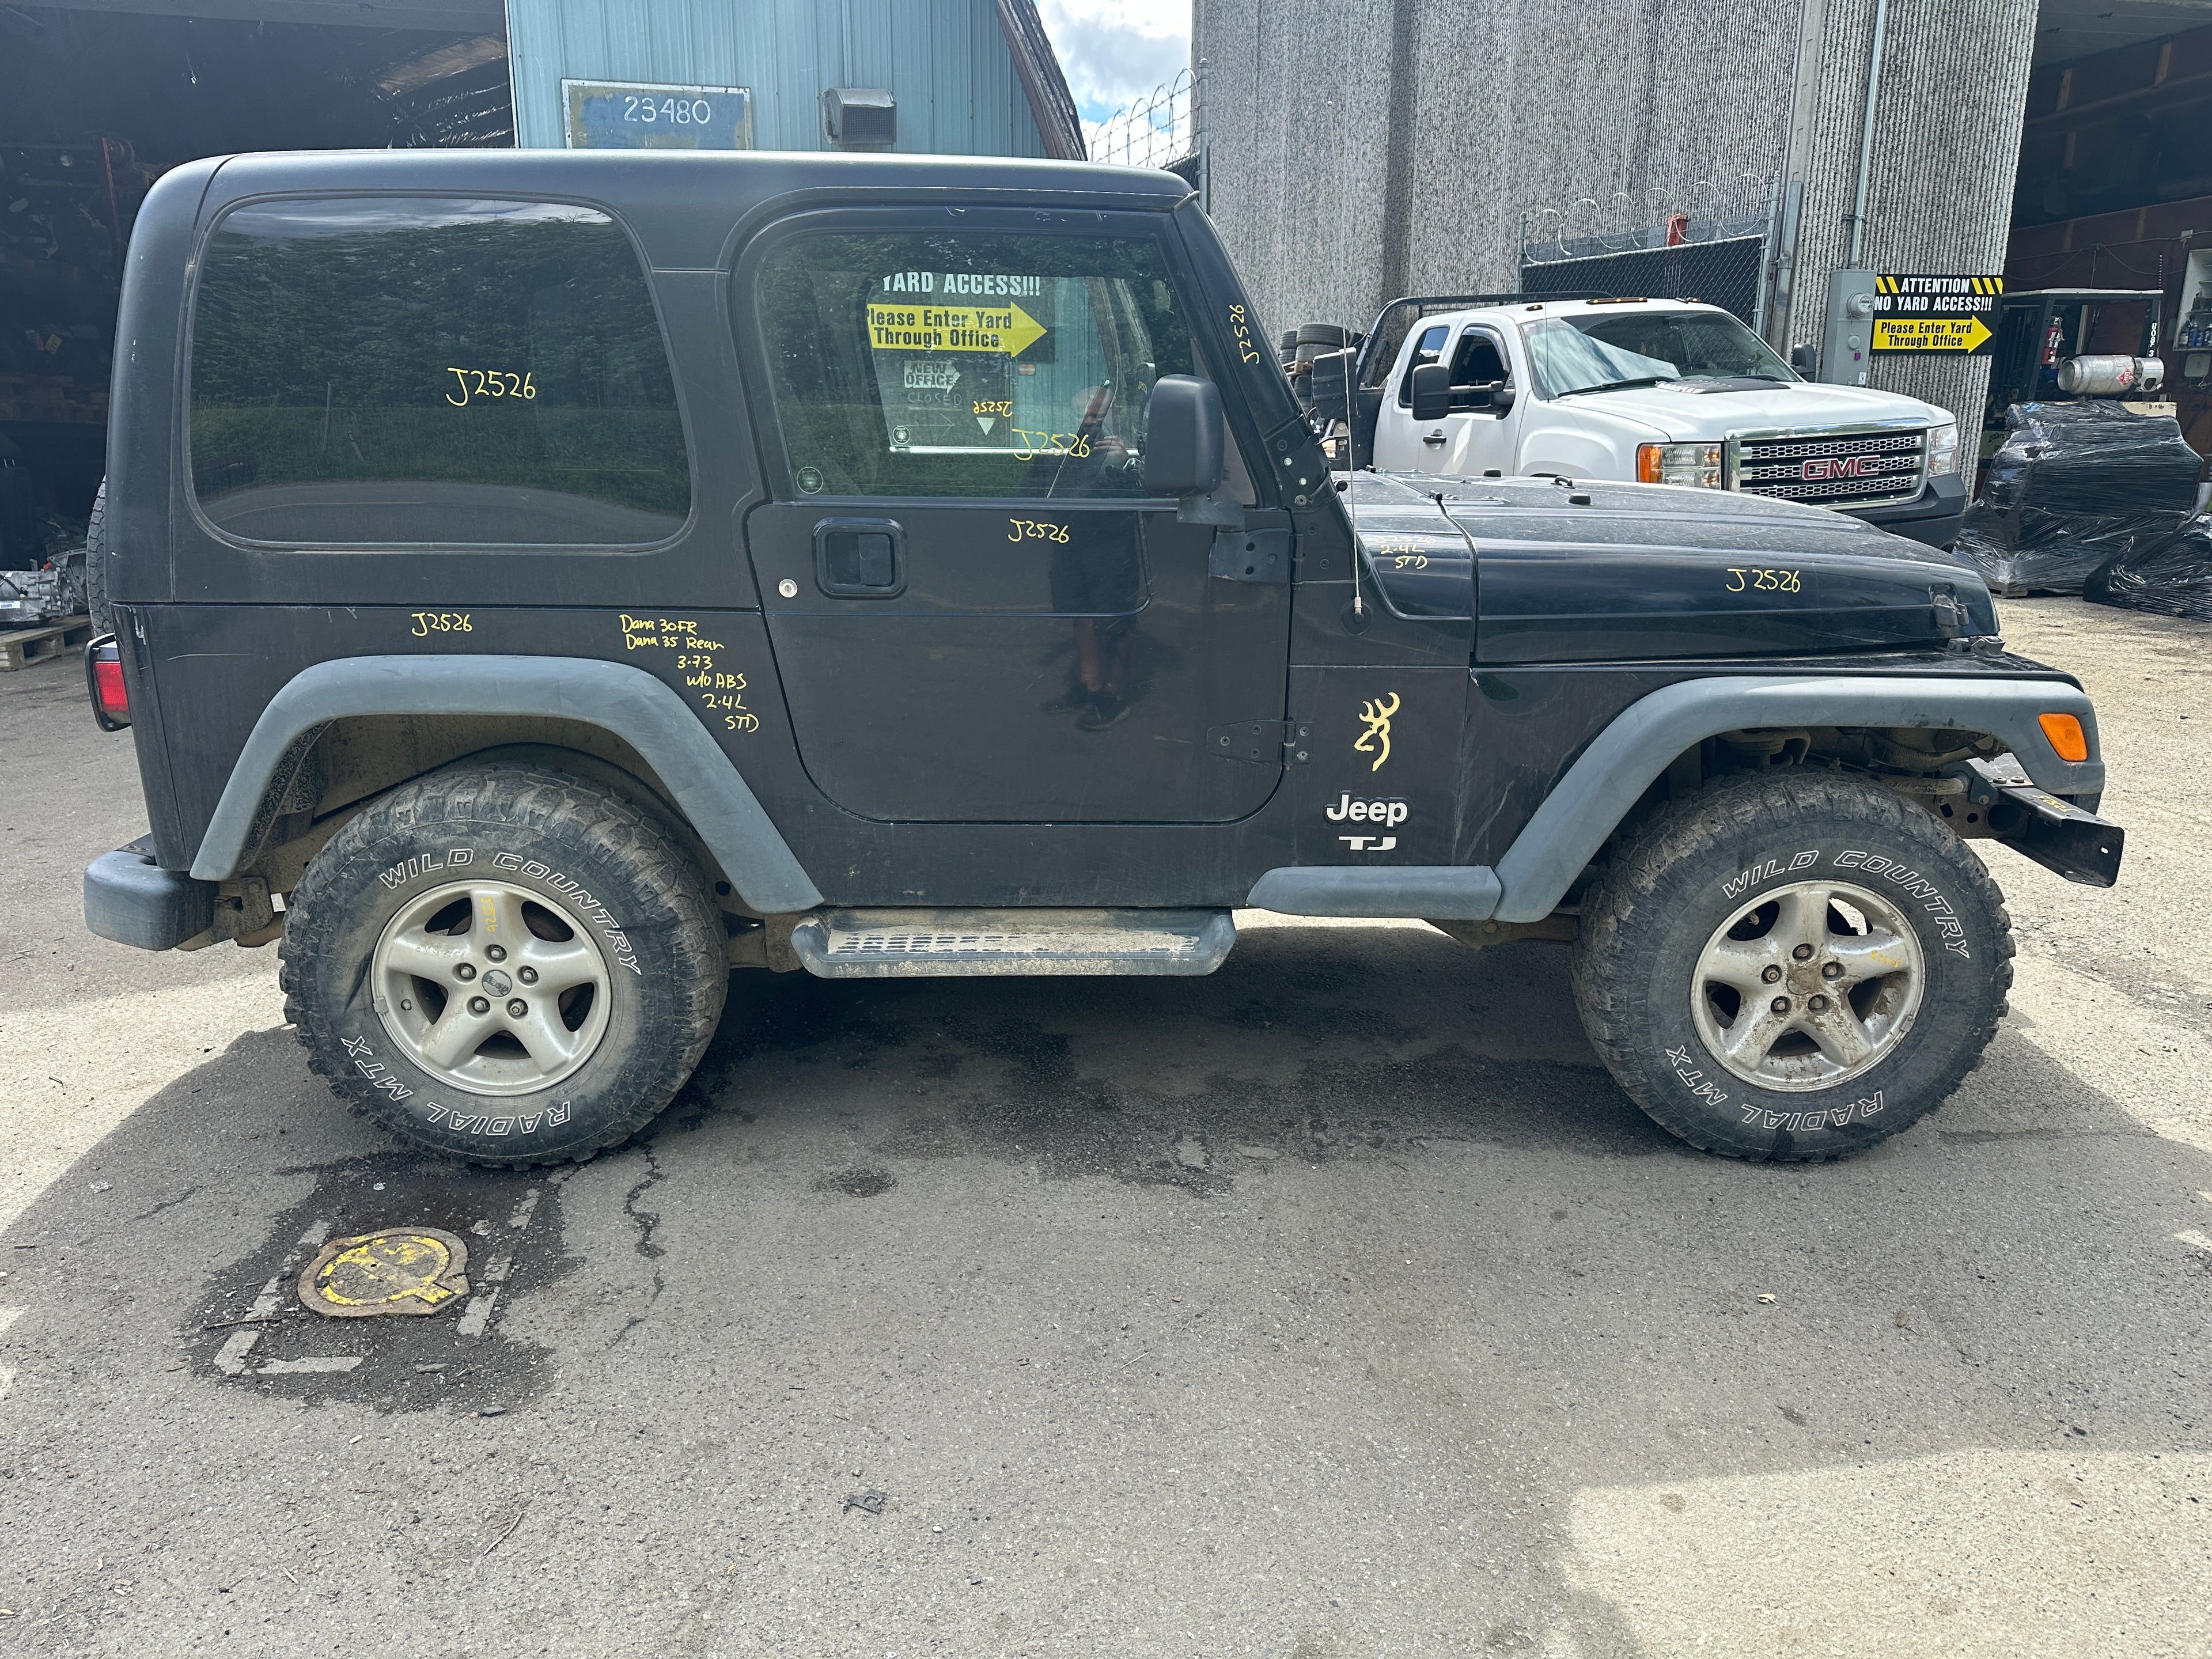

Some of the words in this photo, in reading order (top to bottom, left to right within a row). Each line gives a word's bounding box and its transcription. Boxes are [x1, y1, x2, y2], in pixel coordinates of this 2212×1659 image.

[623, 94, 712, 126] 23480
[943, 274, 1040, 296] ACCESS!!!
[1900, 278, 1970, 293] ATTENTION
[1874, 296, 1892, 311] NO
[1897, 296, 1929, 311] YARD
[1933, 297, 1993, 312] ACCESS!!!
[866, 308, 915, 326] lease
[923, 309, 969, 328] Enter
[976, 311, 1012, 329] Yard
[1880, 321, 1914, 334] Please
[1918, 322, 1946, 334] Enter
[1950, 322, 1972, 334] Yard
[874, 327, 942, 349] Through
[950, 329, 1000, 348] Office
[1229, 304, 1260, 364] J2526
[1888, 335, 1929, 348] Through
[1932, 335, 1963, 347] Office
[445, 367, 537, 407] J2526
[1011, 428, 1090, 461] J2526
[1801, 454, 1881, 480] GMC
[1008, 518, 1070, 543] J2526
[1395, 555, 1428, 569] STD
[1726, 568, 1801, 593] J2526
[411, 612, 473, 637] J2526
[619, 613, 655, 634] Dana
[626, 633, 659, 650] Dana
[662, 635, 679, 647] 35
[685, 637, 725, 651] Rear
[715, 673, 747, 690] ABS
[724, 713, 759, 733] STD
[1325, 794, 1408, 828] Jeep
[1338, 836, 1397, 851] TJ
[378, 847, 474, 890] WILD
[492, 852, 642, 975] COUNTRY
[1722, 850, 1820, 900] WILD
[1833, 850, 1970, 959] COUNTRY
[340, 1035, 414, 1102] MTX
[1665, 1044, 1728, 1107] MTX
[426, 1100, 571, 1137] RADIAL
[1741, 1090, 1884, 1132] RADIAL
